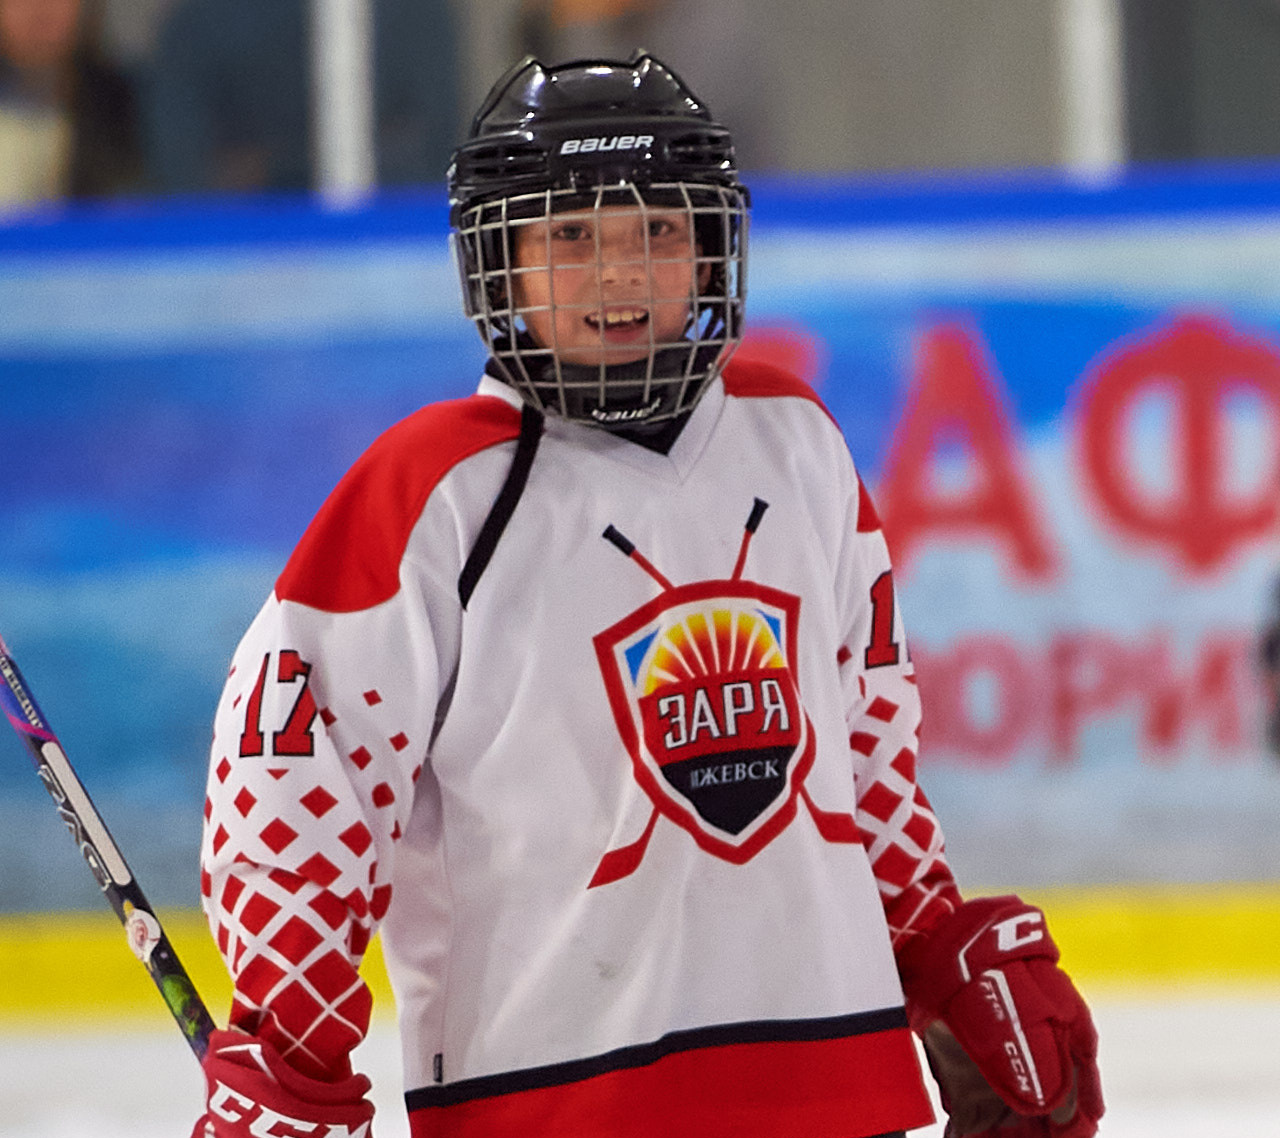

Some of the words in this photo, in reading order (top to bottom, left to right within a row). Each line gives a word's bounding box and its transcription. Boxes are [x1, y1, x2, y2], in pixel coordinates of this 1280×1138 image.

[560, 135, 655, 155] BAUER
[863, 569, 913, 671] 1
[238, 649, 319, 758] 17
[658, 679, 792, 750] ЗАРЯ
[1003, 1040, 1031, 1093] CCM
